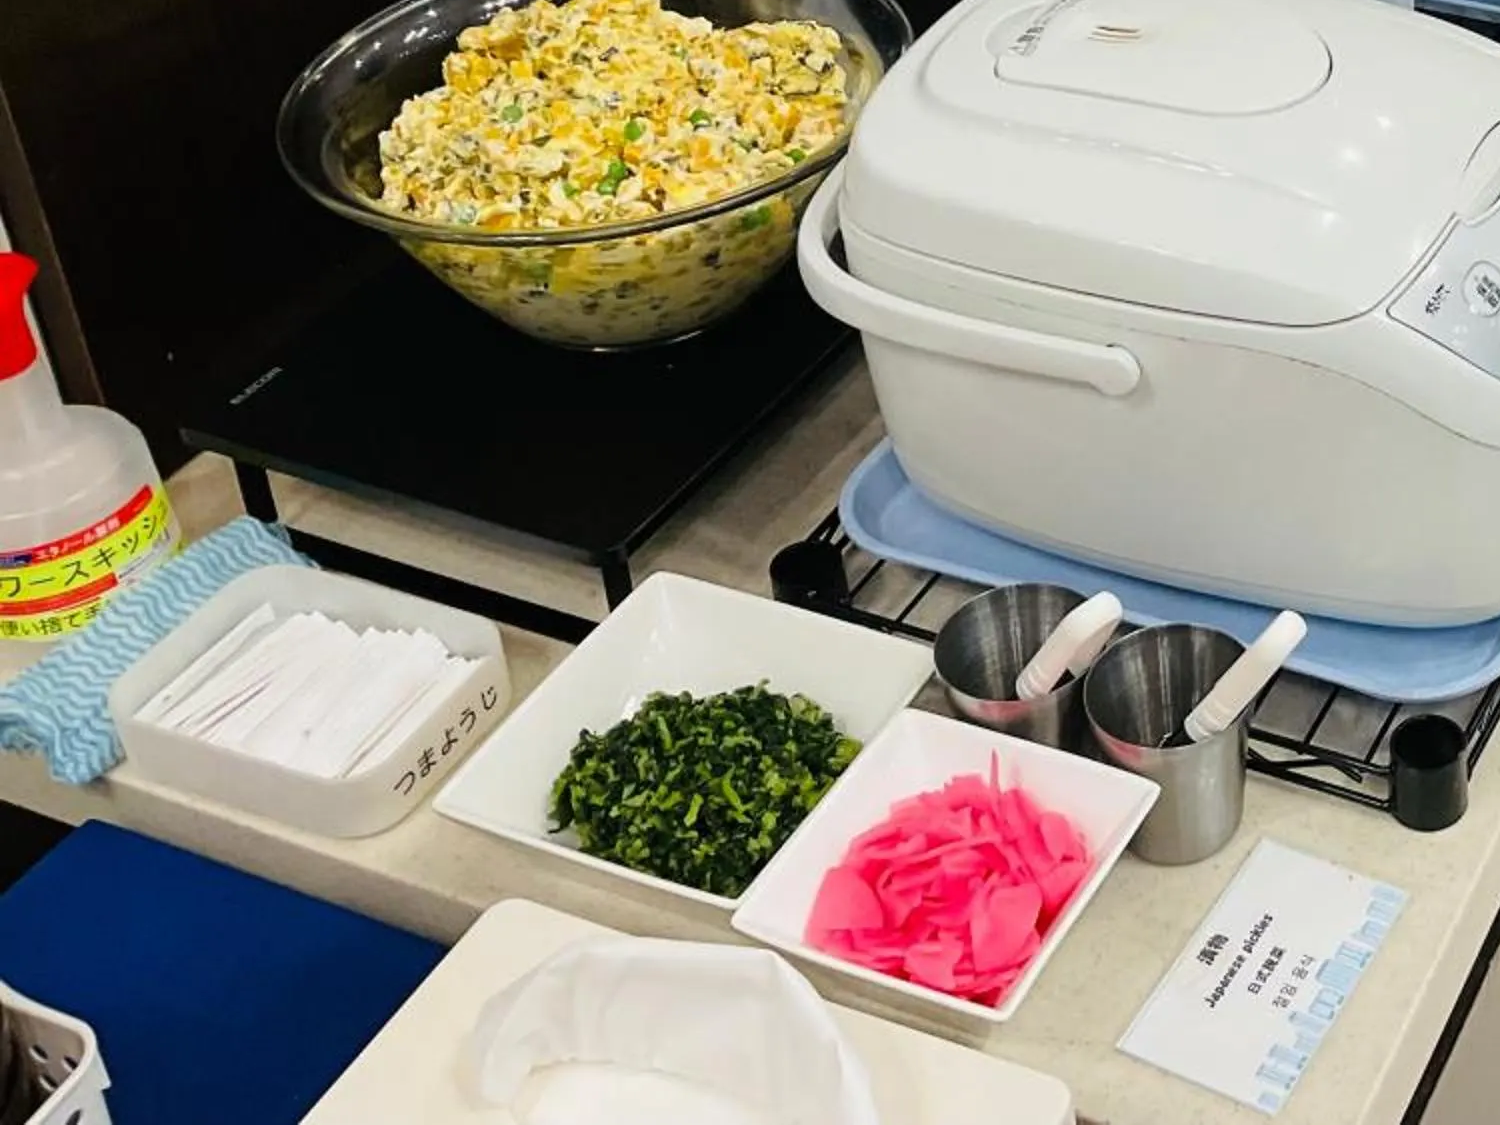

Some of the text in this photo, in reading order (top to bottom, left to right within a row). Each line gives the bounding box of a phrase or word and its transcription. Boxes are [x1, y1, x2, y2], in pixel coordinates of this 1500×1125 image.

[393, 685, 498, 796] つまようじ
[1203, 913, 1273, 1008] Japanese pickles
